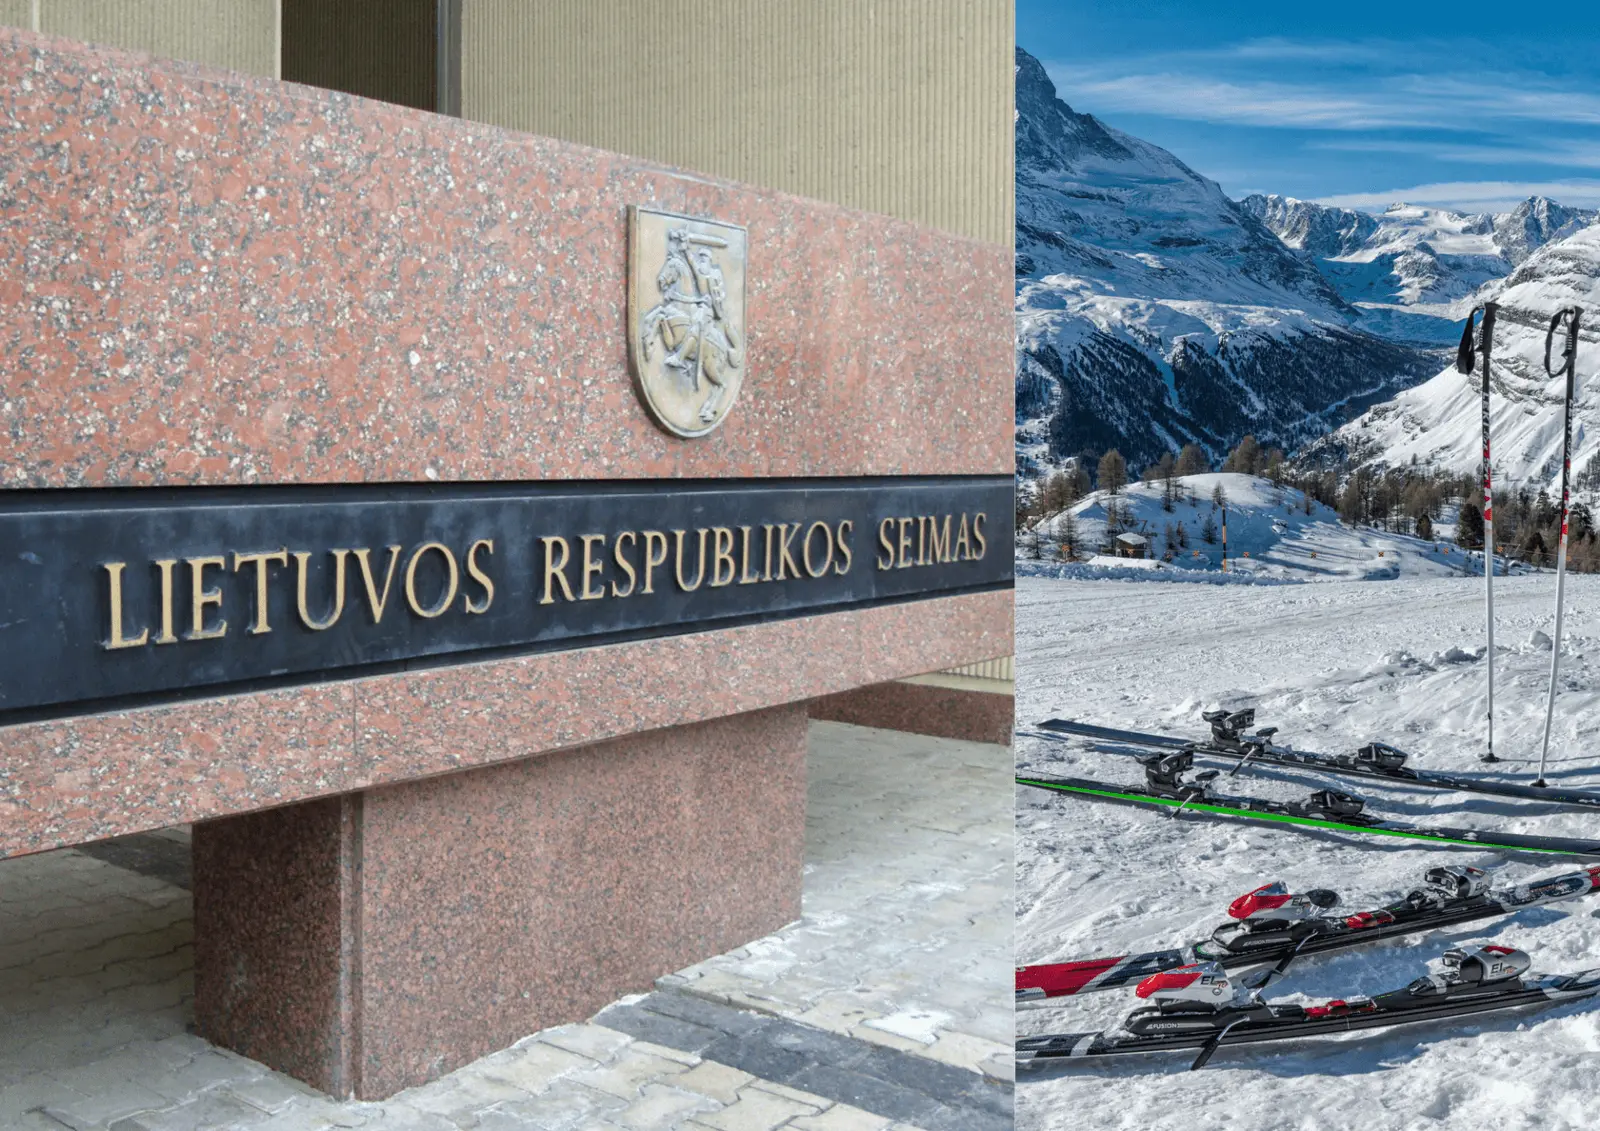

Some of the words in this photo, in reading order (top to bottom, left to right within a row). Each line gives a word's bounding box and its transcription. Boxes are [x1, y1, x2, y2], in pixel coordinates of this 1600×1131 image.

[101, 539, 495, 651] LIETUVOS
[538, 519, 854, 605] RESPUBLIKOS
[876, 512, 988, 572] SEIMAS
